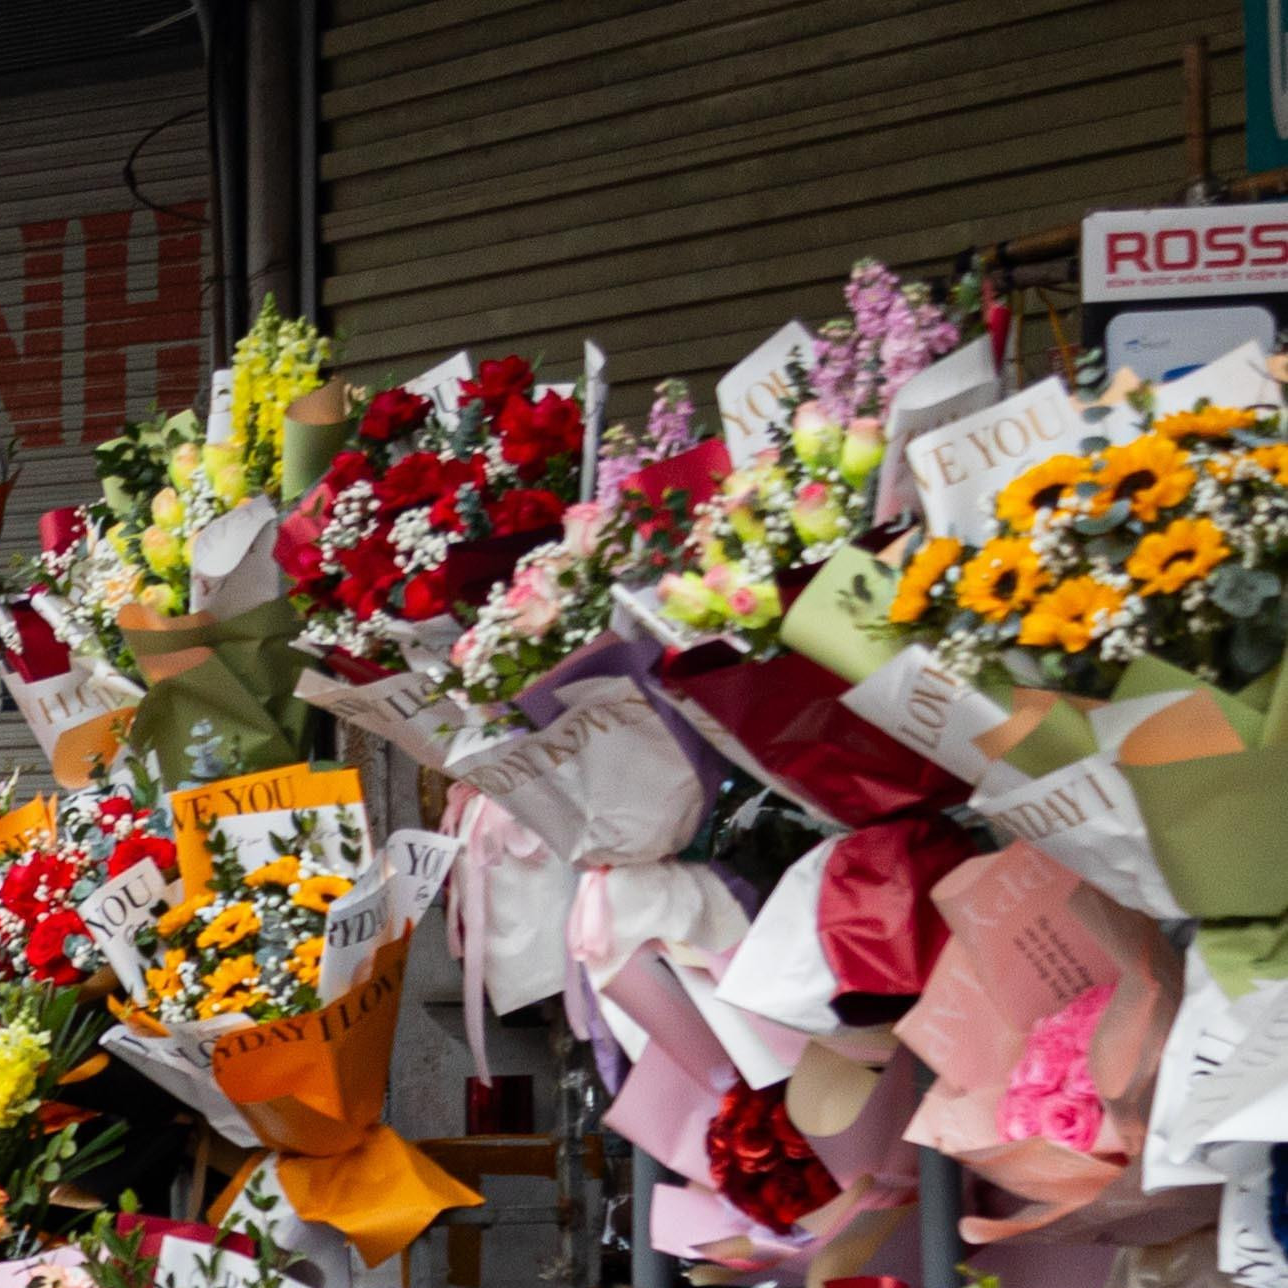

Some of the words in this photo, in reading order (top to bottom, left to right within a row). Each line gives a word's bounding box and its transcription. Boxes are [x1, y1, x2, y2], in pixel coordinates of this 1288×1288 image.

[968, 394, 1065, 468] YOU
[221, 776, 297, 815] YOU
[85, 873, 153, 938] YOU
